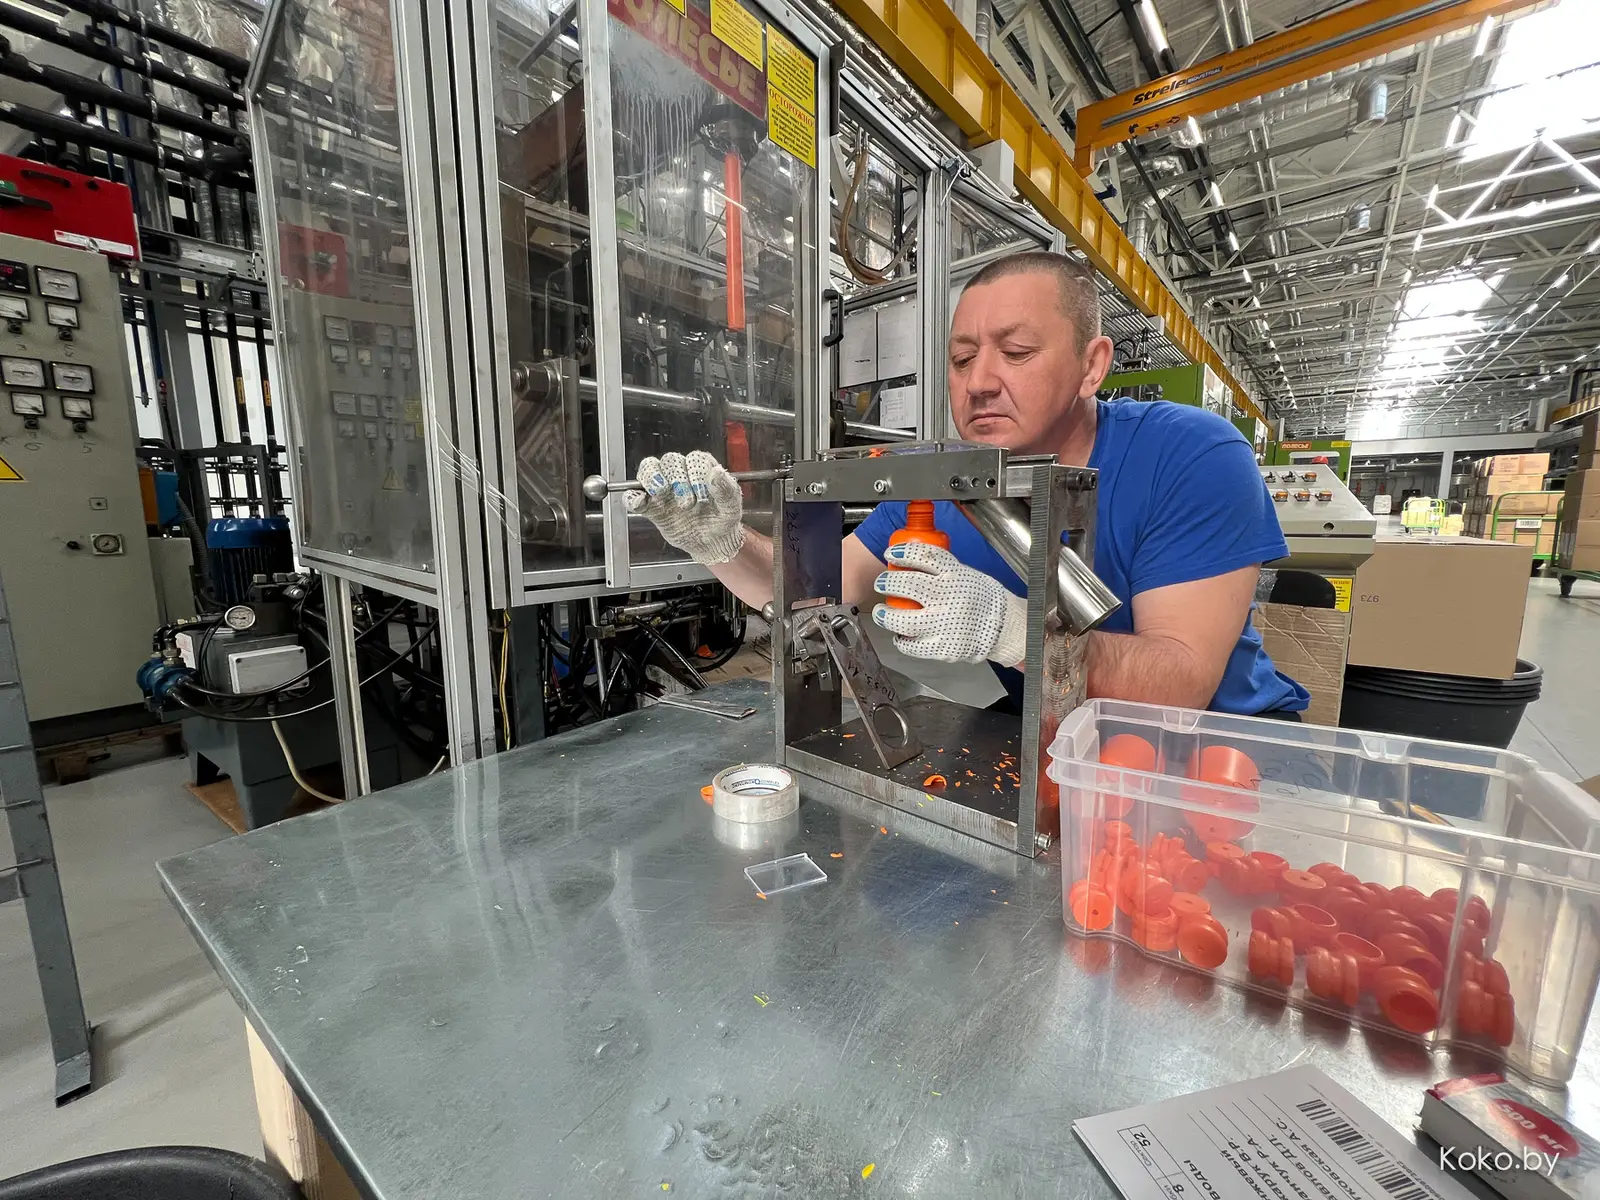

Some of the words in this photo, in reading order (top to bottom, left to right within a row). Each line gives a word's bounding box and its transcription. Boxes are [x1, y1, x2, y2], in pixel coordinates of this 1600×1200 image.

[609, 0, 758, 102] ОЛЕСЬЕ
[1132, 78, 1188, 106] Strele
[1360, 594, 1380, 603] 973
[1133, 1131, 1151, 1147] 52
[1276, 1117, 1301, 1141] А.С.
[1228, 1137, 1252, 1162] В.Р.
[1247, 1134, 1270, 1159] Р.А.
[1172, 1184, 1184, 1193] 8
[1269, 1161, 1312, 1200] анчук
